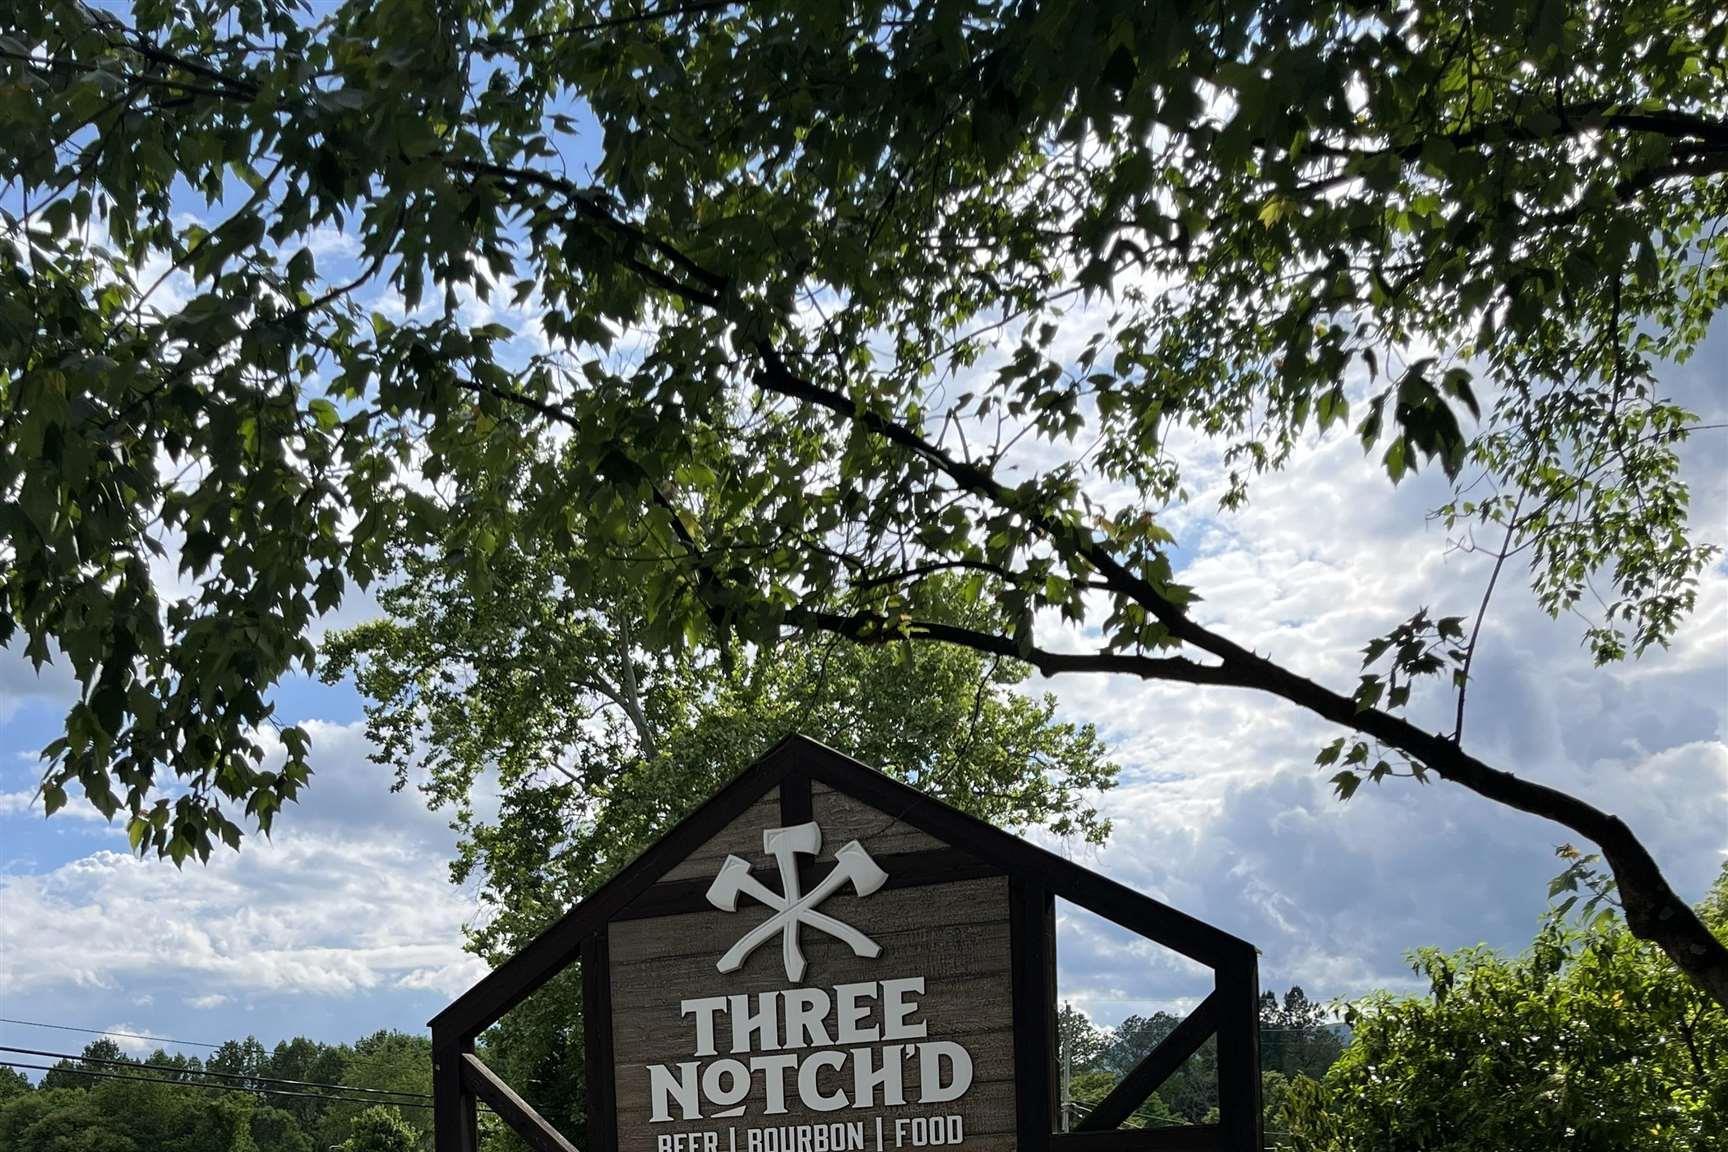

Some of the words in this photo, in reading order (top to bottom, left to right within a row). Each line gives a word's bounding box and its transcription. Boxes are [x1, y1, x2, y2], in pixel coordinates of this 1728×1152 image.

[680, 976, 928, 1057] THREE
[646, 1040, 973, 1122] NOTCH'D
[895, 1114, 964, 1148] FOOD
